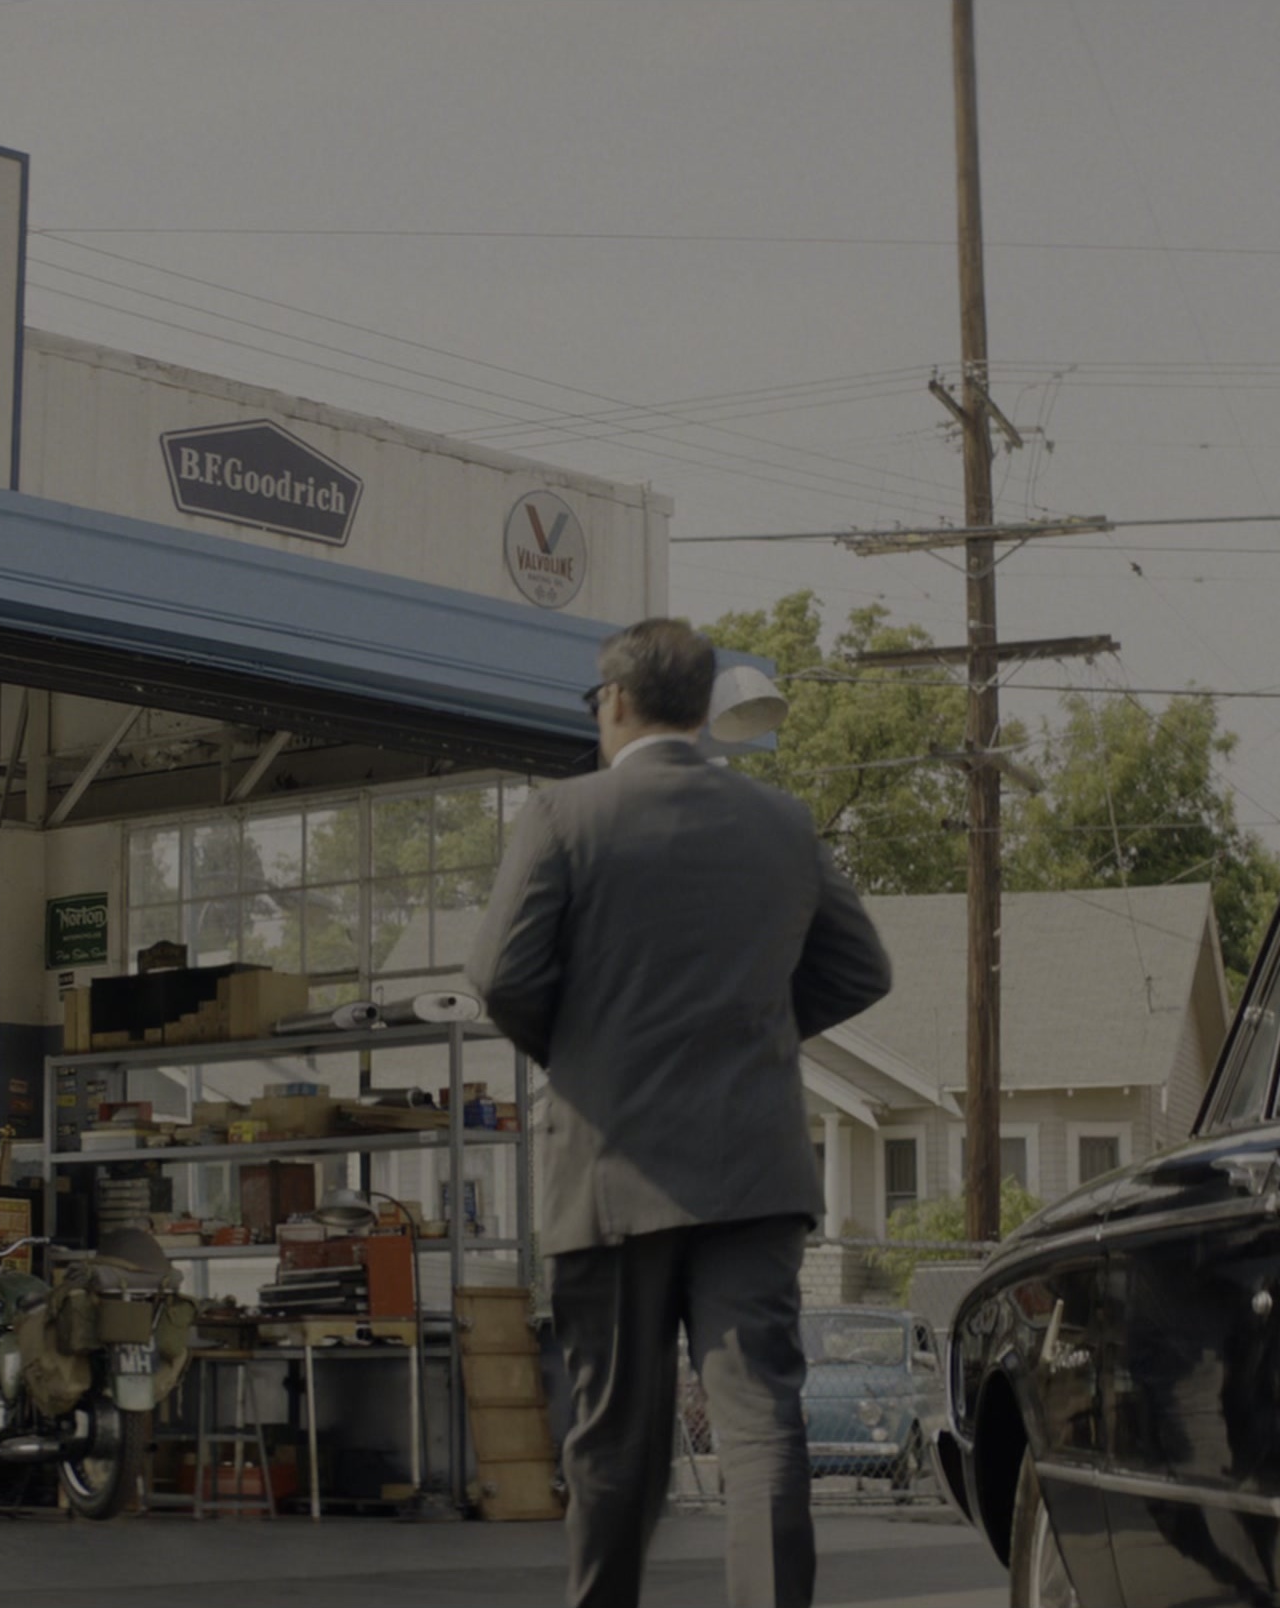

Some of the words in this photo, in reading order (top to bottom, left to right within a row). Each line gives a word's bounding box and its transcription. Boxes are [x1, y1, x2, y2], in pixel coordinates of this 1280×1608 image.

[179, 446, 346, 515] B.F.Goodrich
[516, 544, 574, 582] VALVOLINE
[56, 903, 108, 932] Norton
